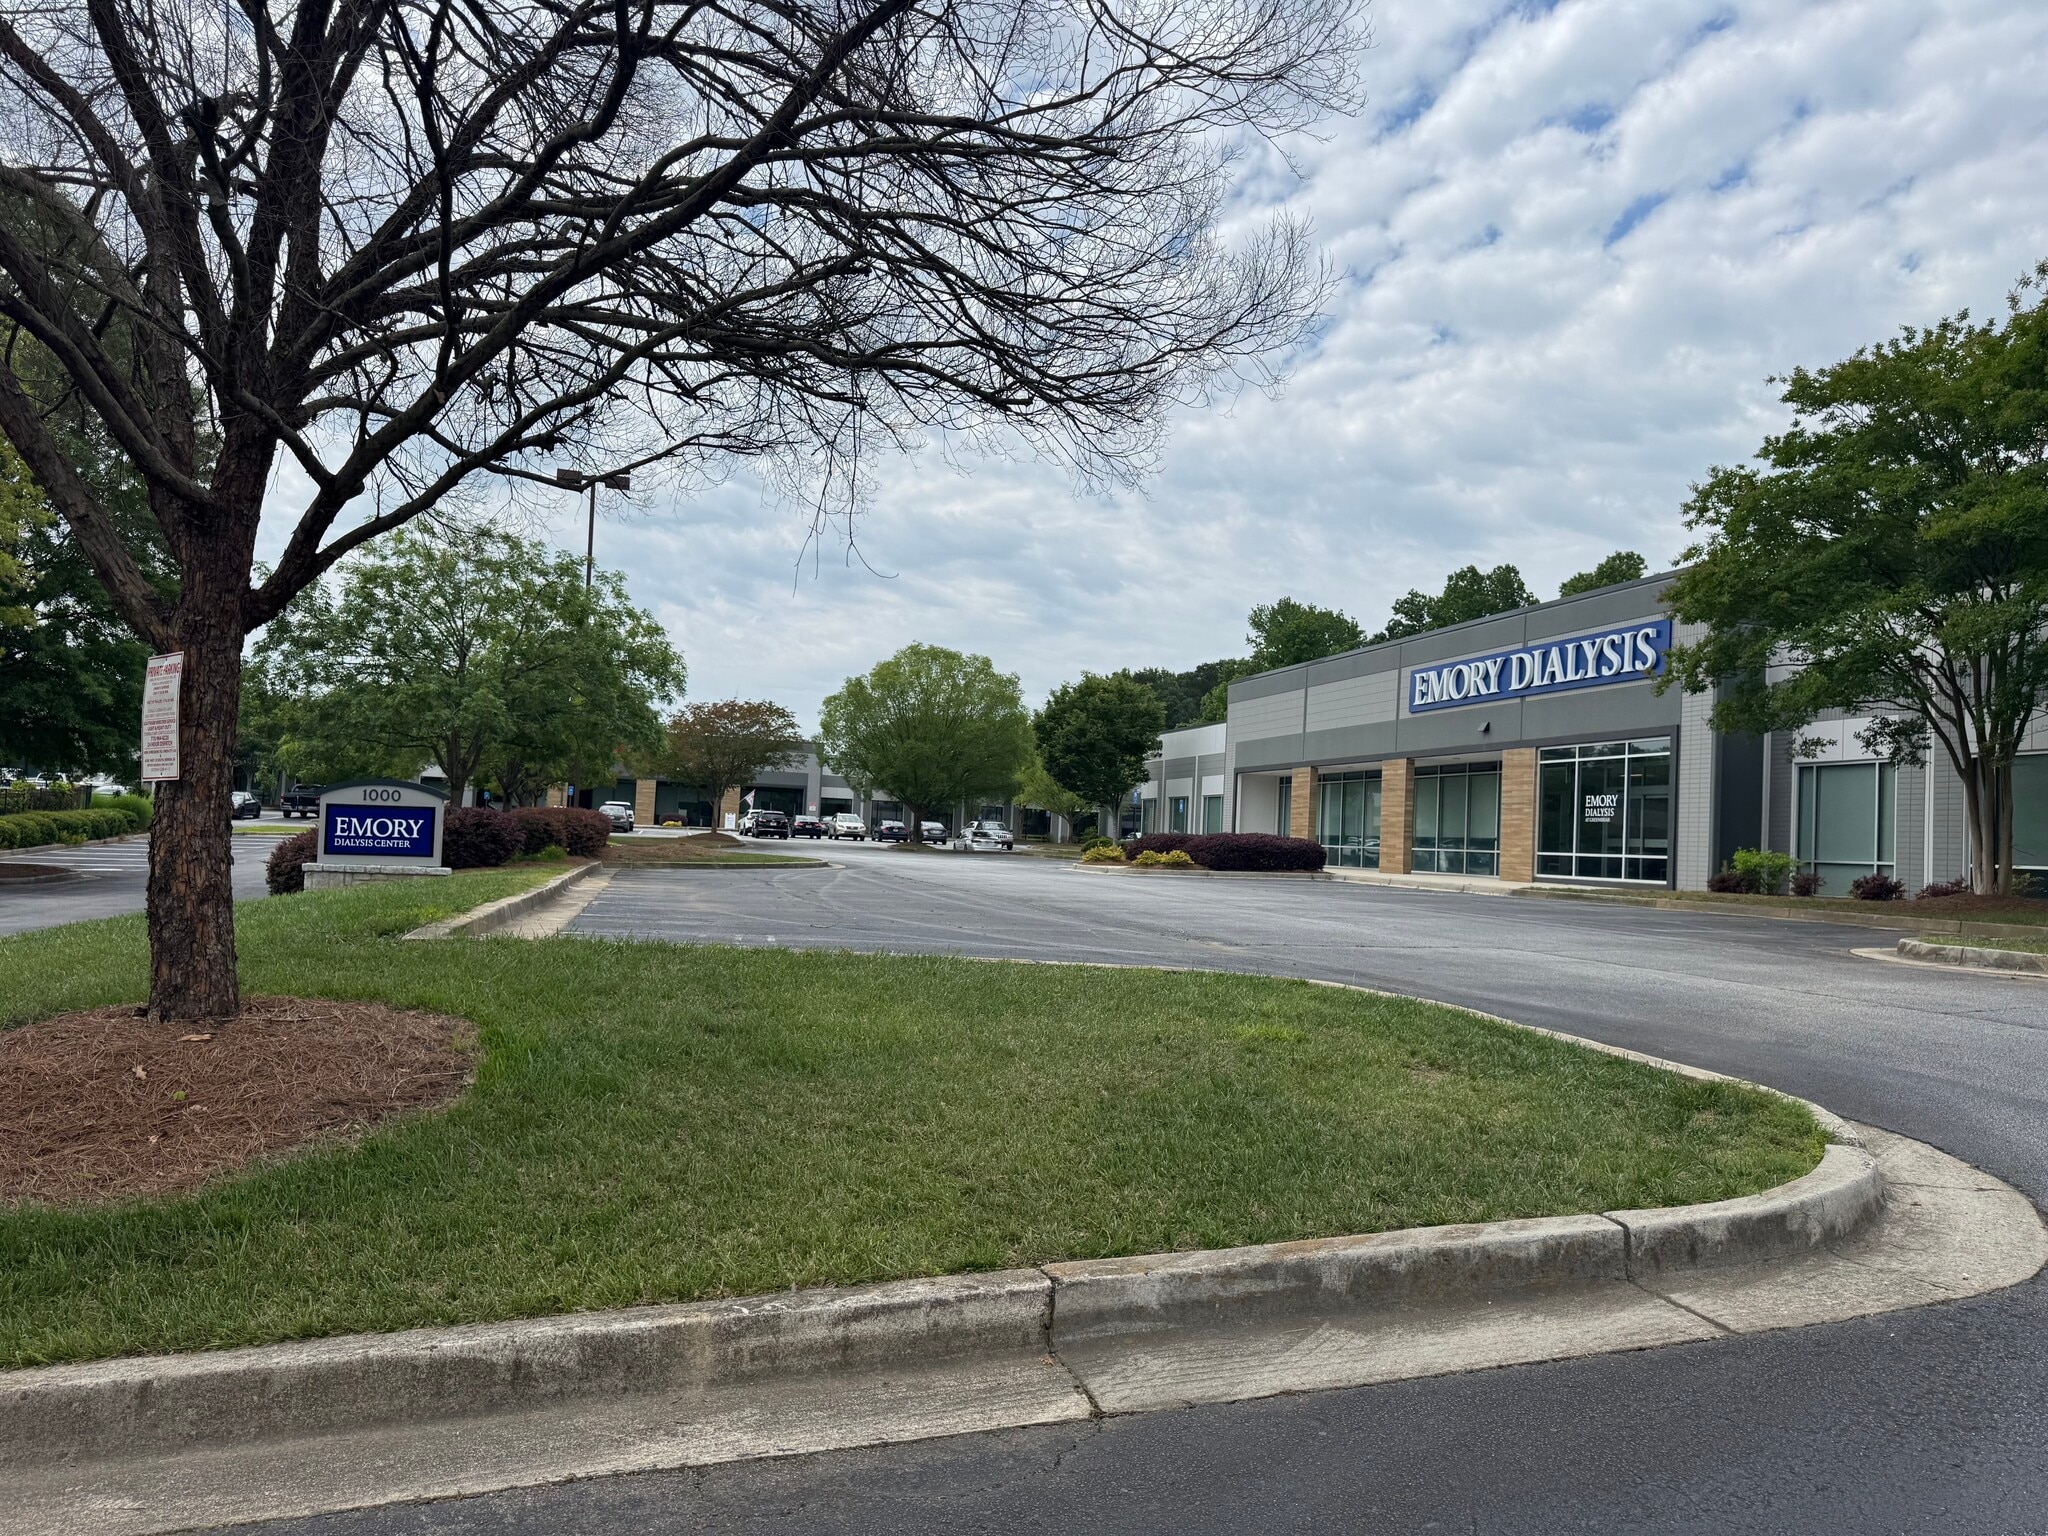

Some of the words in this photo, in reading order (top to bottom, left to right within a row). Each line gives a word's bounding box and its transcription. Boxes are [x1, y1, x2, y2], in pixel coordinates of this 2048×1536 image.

[1413, 657, 1506, 706] EMORY
[1508, 628, 1658, 691] DIALYSIS
[363, 789, 401, 802] 1000
[1585, 794, 1619, 807] EMORY
[1585, 808, 1615, 817] DIALYSIS
[334, 817, 425, 838] EMORY
[334, 838, 374, 847] DIALYSIS
[374, 839, 411, 848] CENTER
